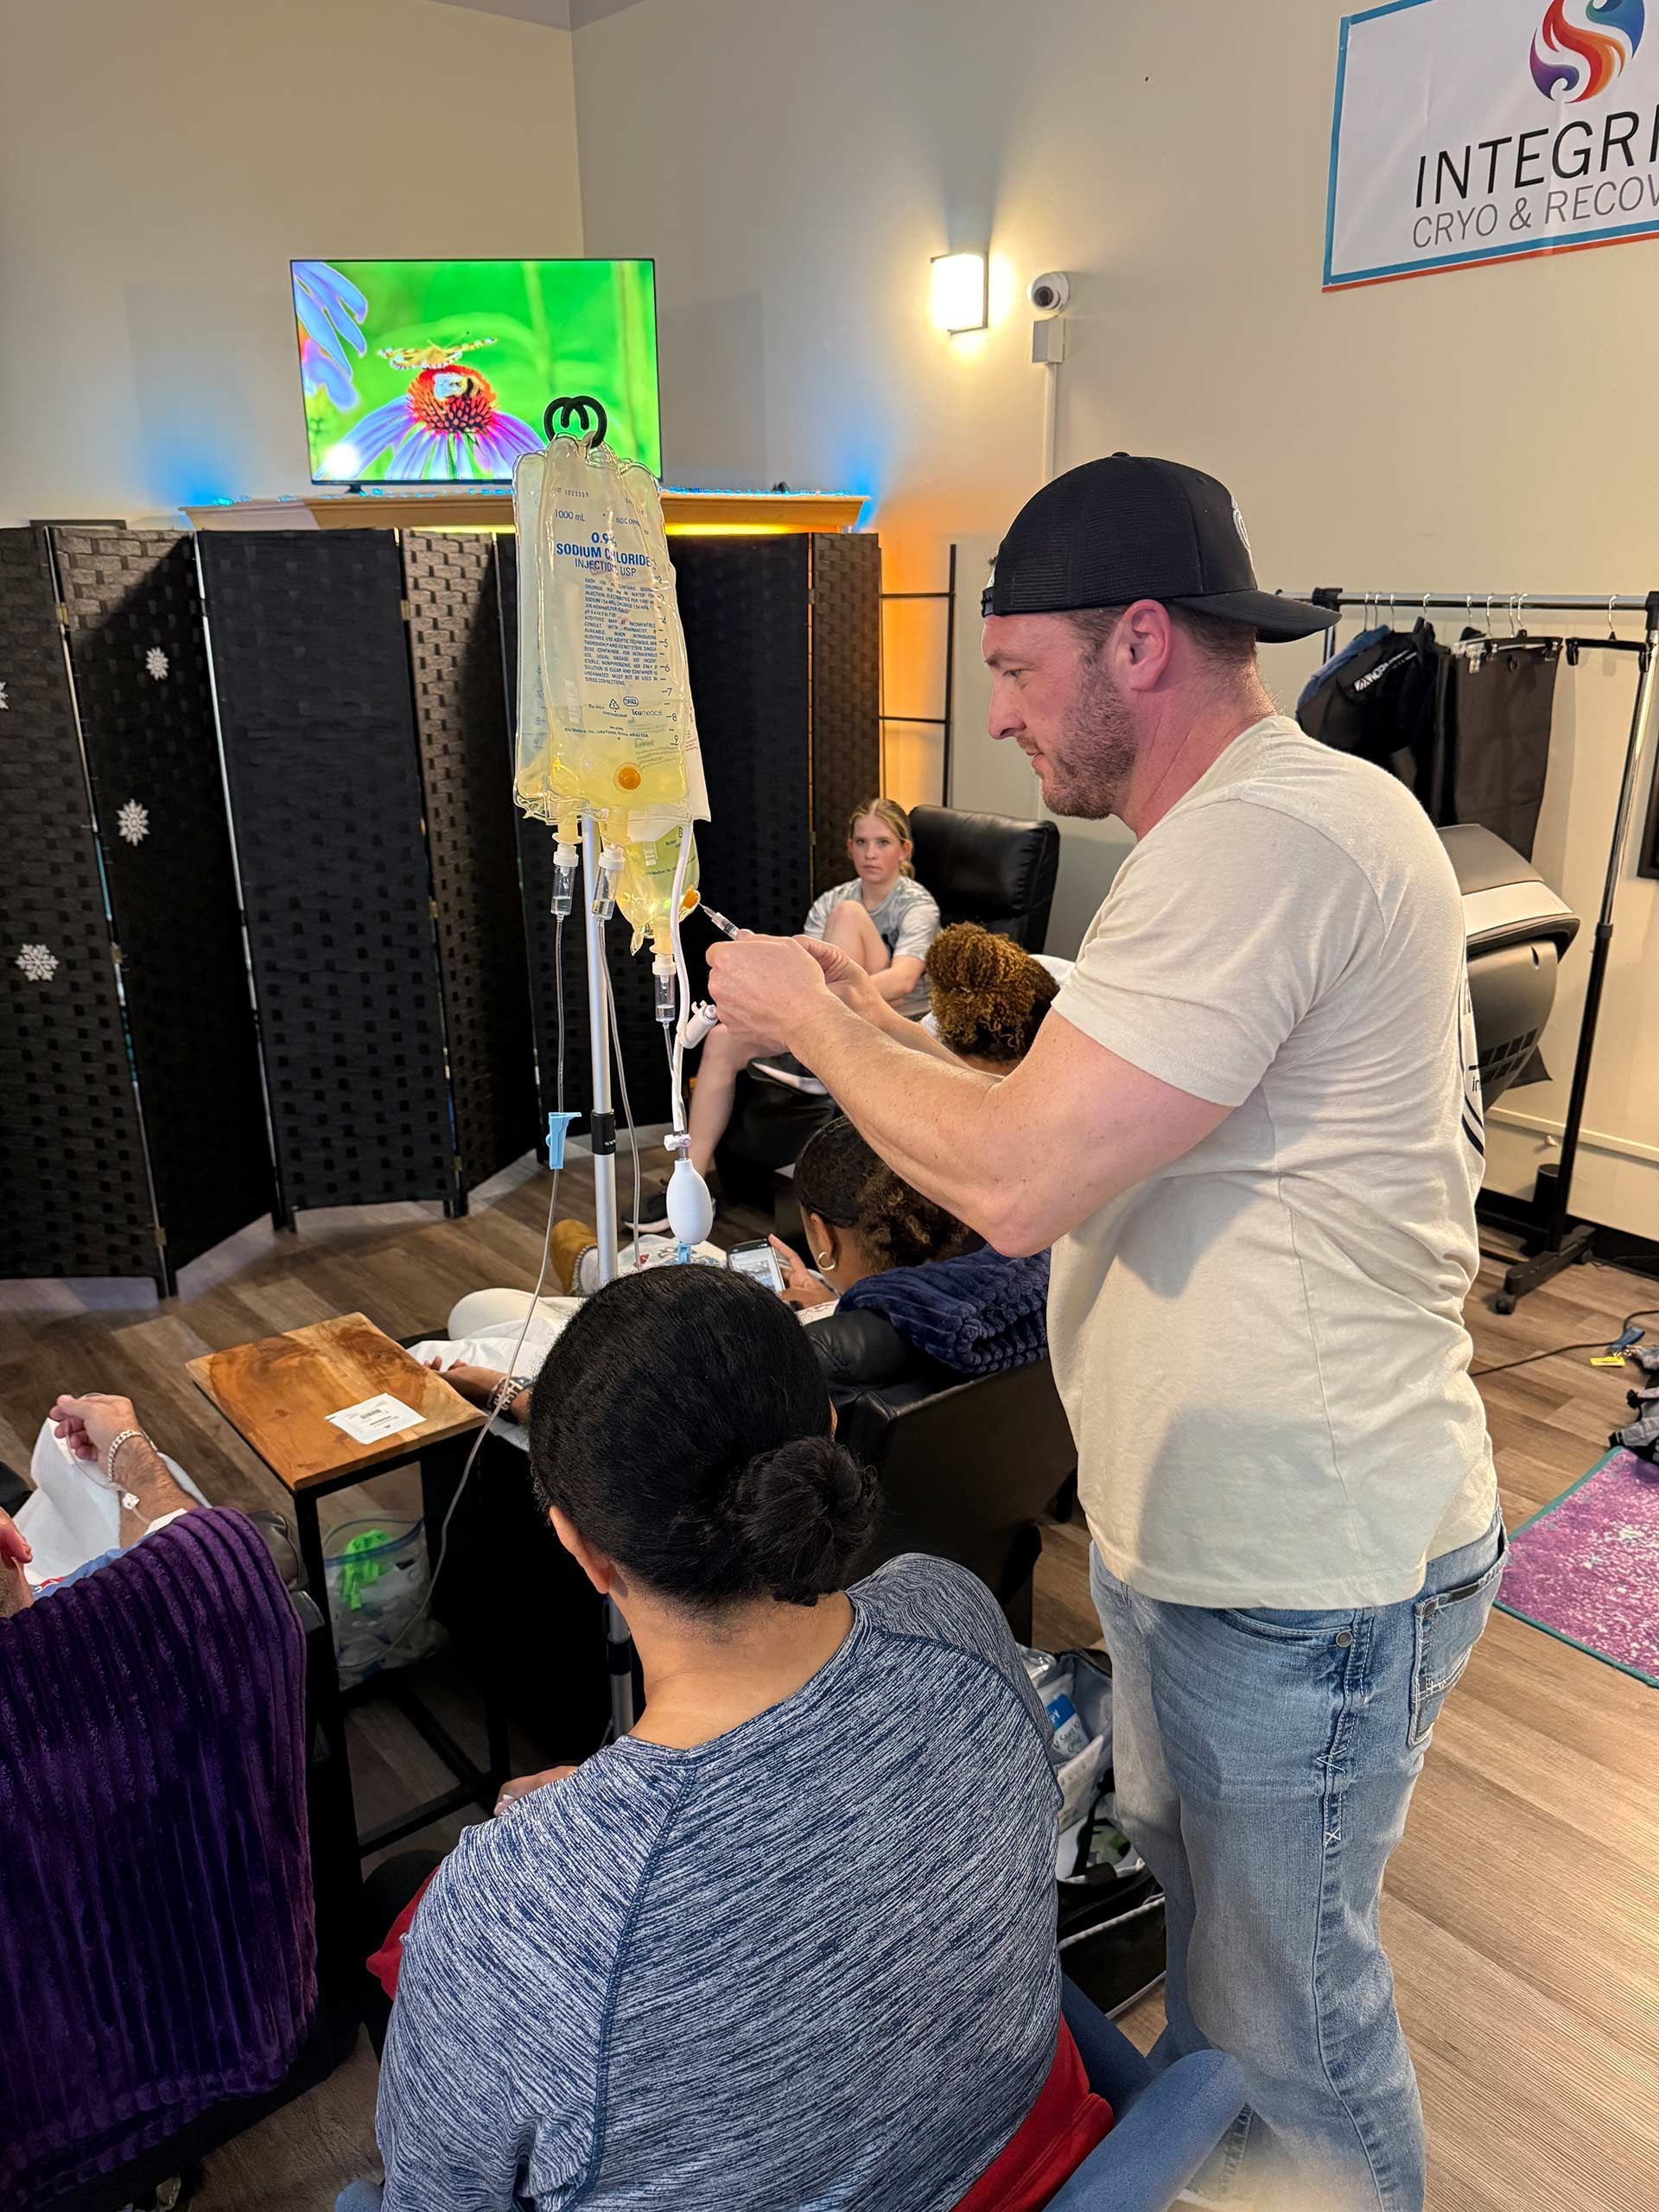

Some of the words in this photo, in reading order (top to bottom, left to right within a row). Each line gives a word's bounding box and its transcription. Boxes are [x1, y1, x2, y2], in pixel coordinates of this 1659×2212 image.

[1415, 104, 1659, 207] INTEGRI
[1413, 203, 1498, 248] CRYO
[1509, 197, 1532, 231] &
[1545, 174, 1659, 225] RECOV
[555, 509, 574, 520] 1000
[575, 512, 585, 522] mL
[556, 543, 601, 558] SODIUM
[620, 566, 637, 576] USP
